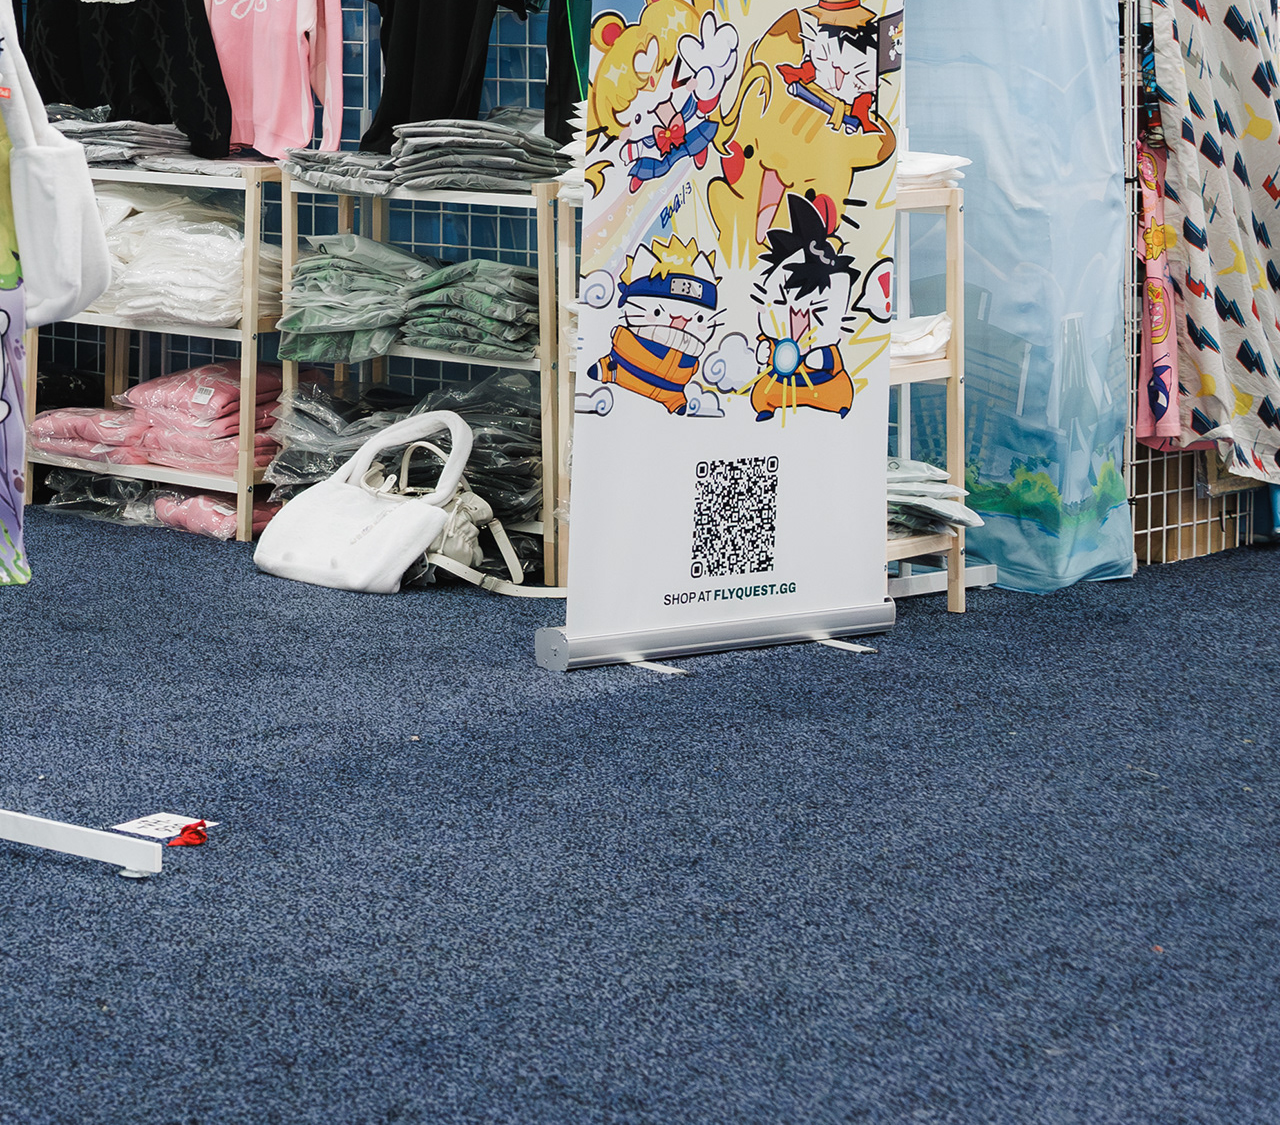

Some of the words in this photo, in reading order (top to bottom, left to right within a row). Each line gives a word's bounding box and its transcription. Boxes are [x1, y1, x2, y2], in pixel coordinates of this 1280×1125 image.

[663, 591, 696, 606] SHOP
[697, 589, 712, 603] AT
[713, 582, 797, 601] FLYQUEST.GG
